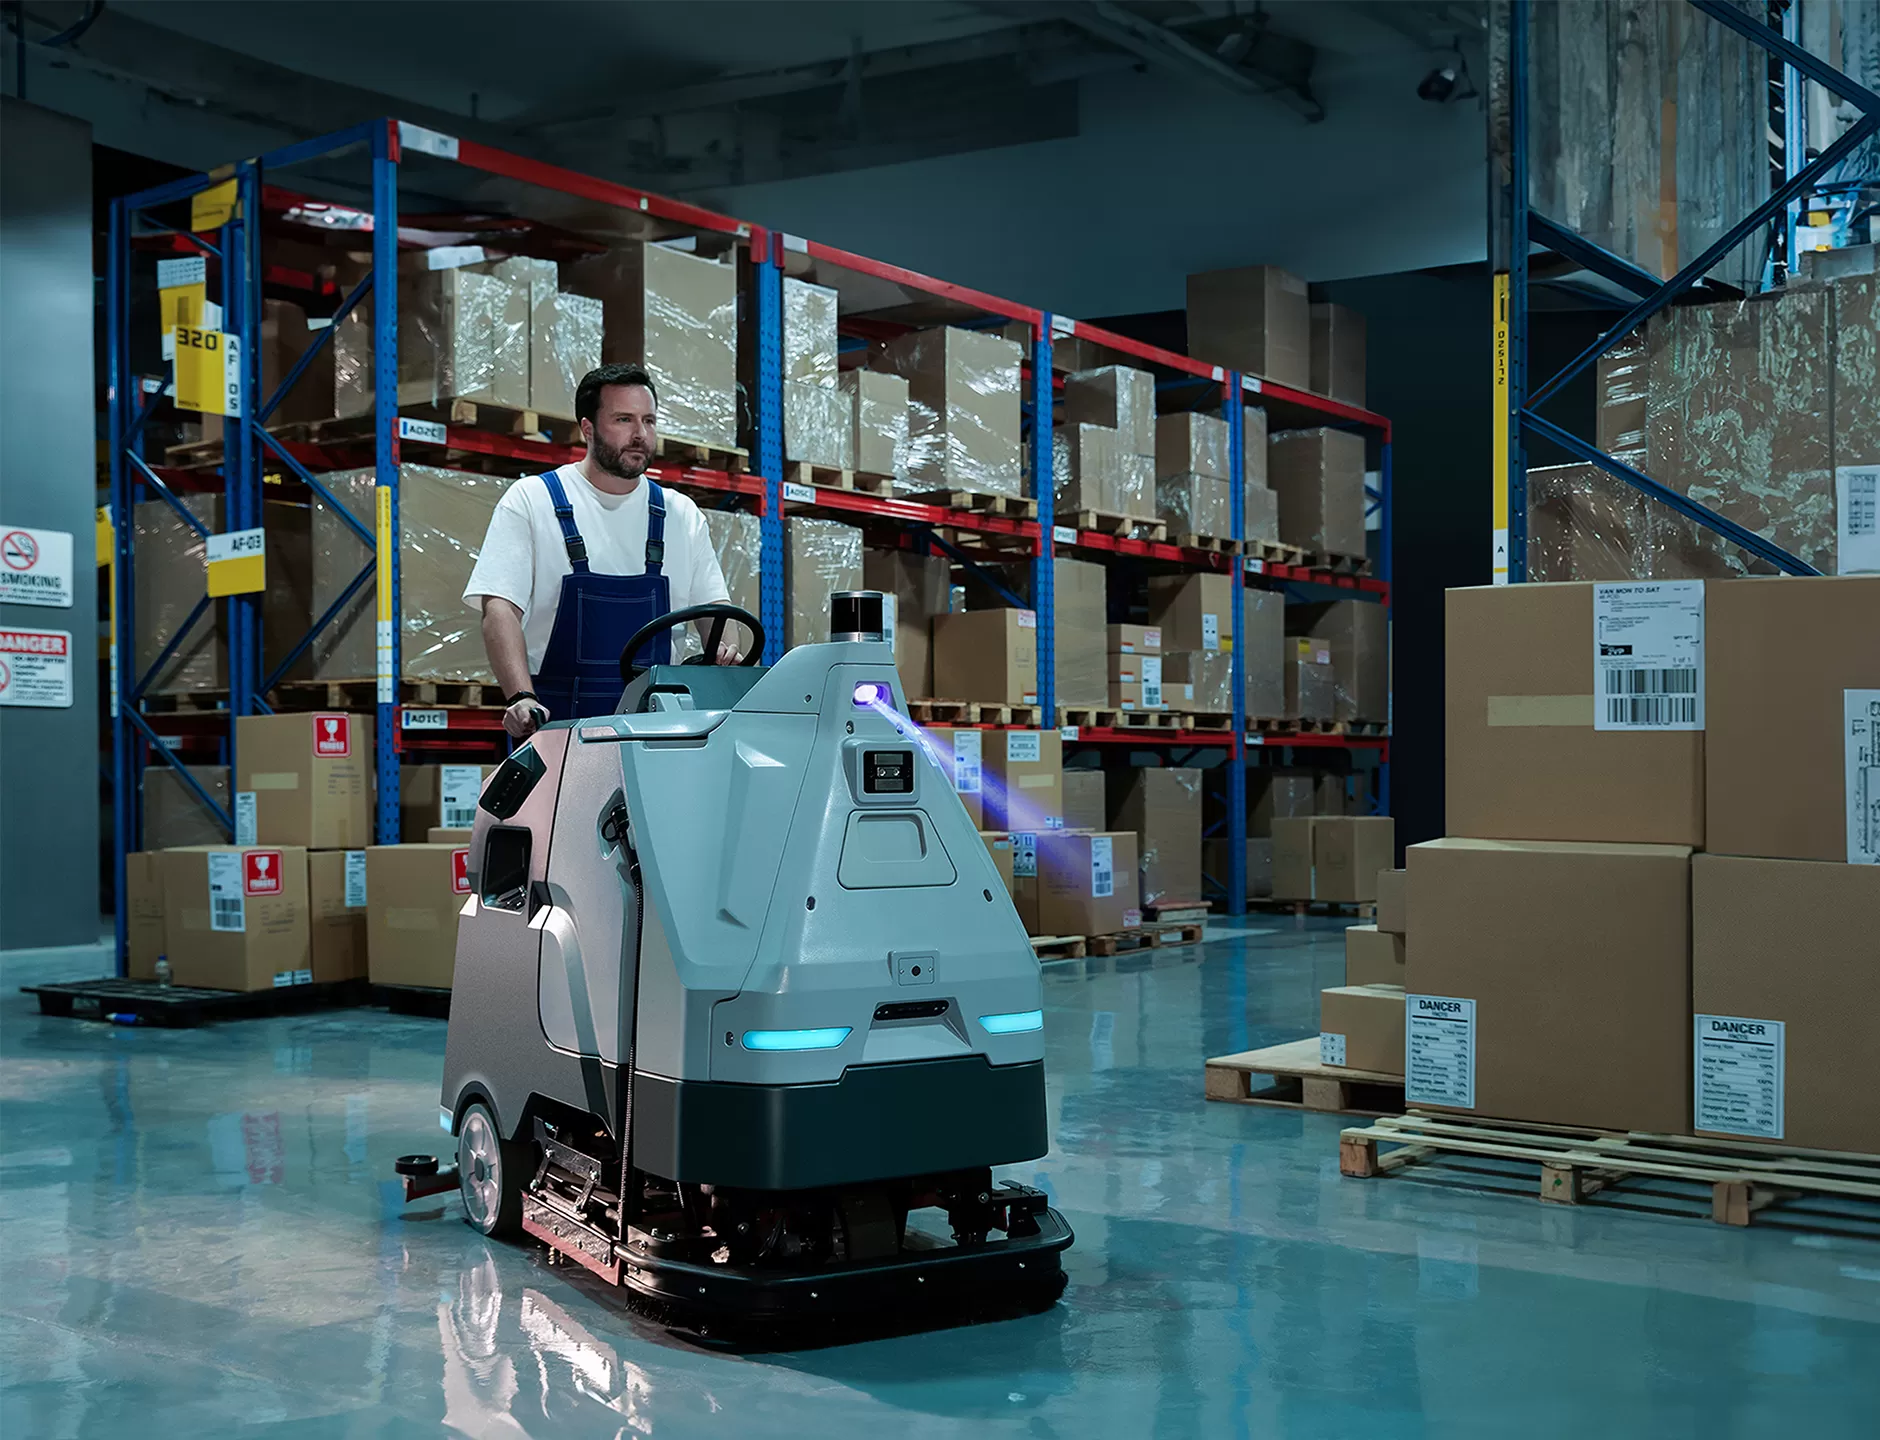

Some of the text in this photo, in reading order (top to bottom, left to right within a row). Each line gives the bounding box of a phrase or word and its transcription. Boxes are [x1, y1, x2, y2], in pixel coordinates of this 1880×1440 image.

[177, 327, 218, 351] 320
[231, 535, 261, 551] AF-03
[1497, 545, 1505, 553] A
[1645, 586, 1661, 594] SAT
[1419, 999, 1462, 1013] DANCER
[1711, 1020, 1766, 1036] DANCER
